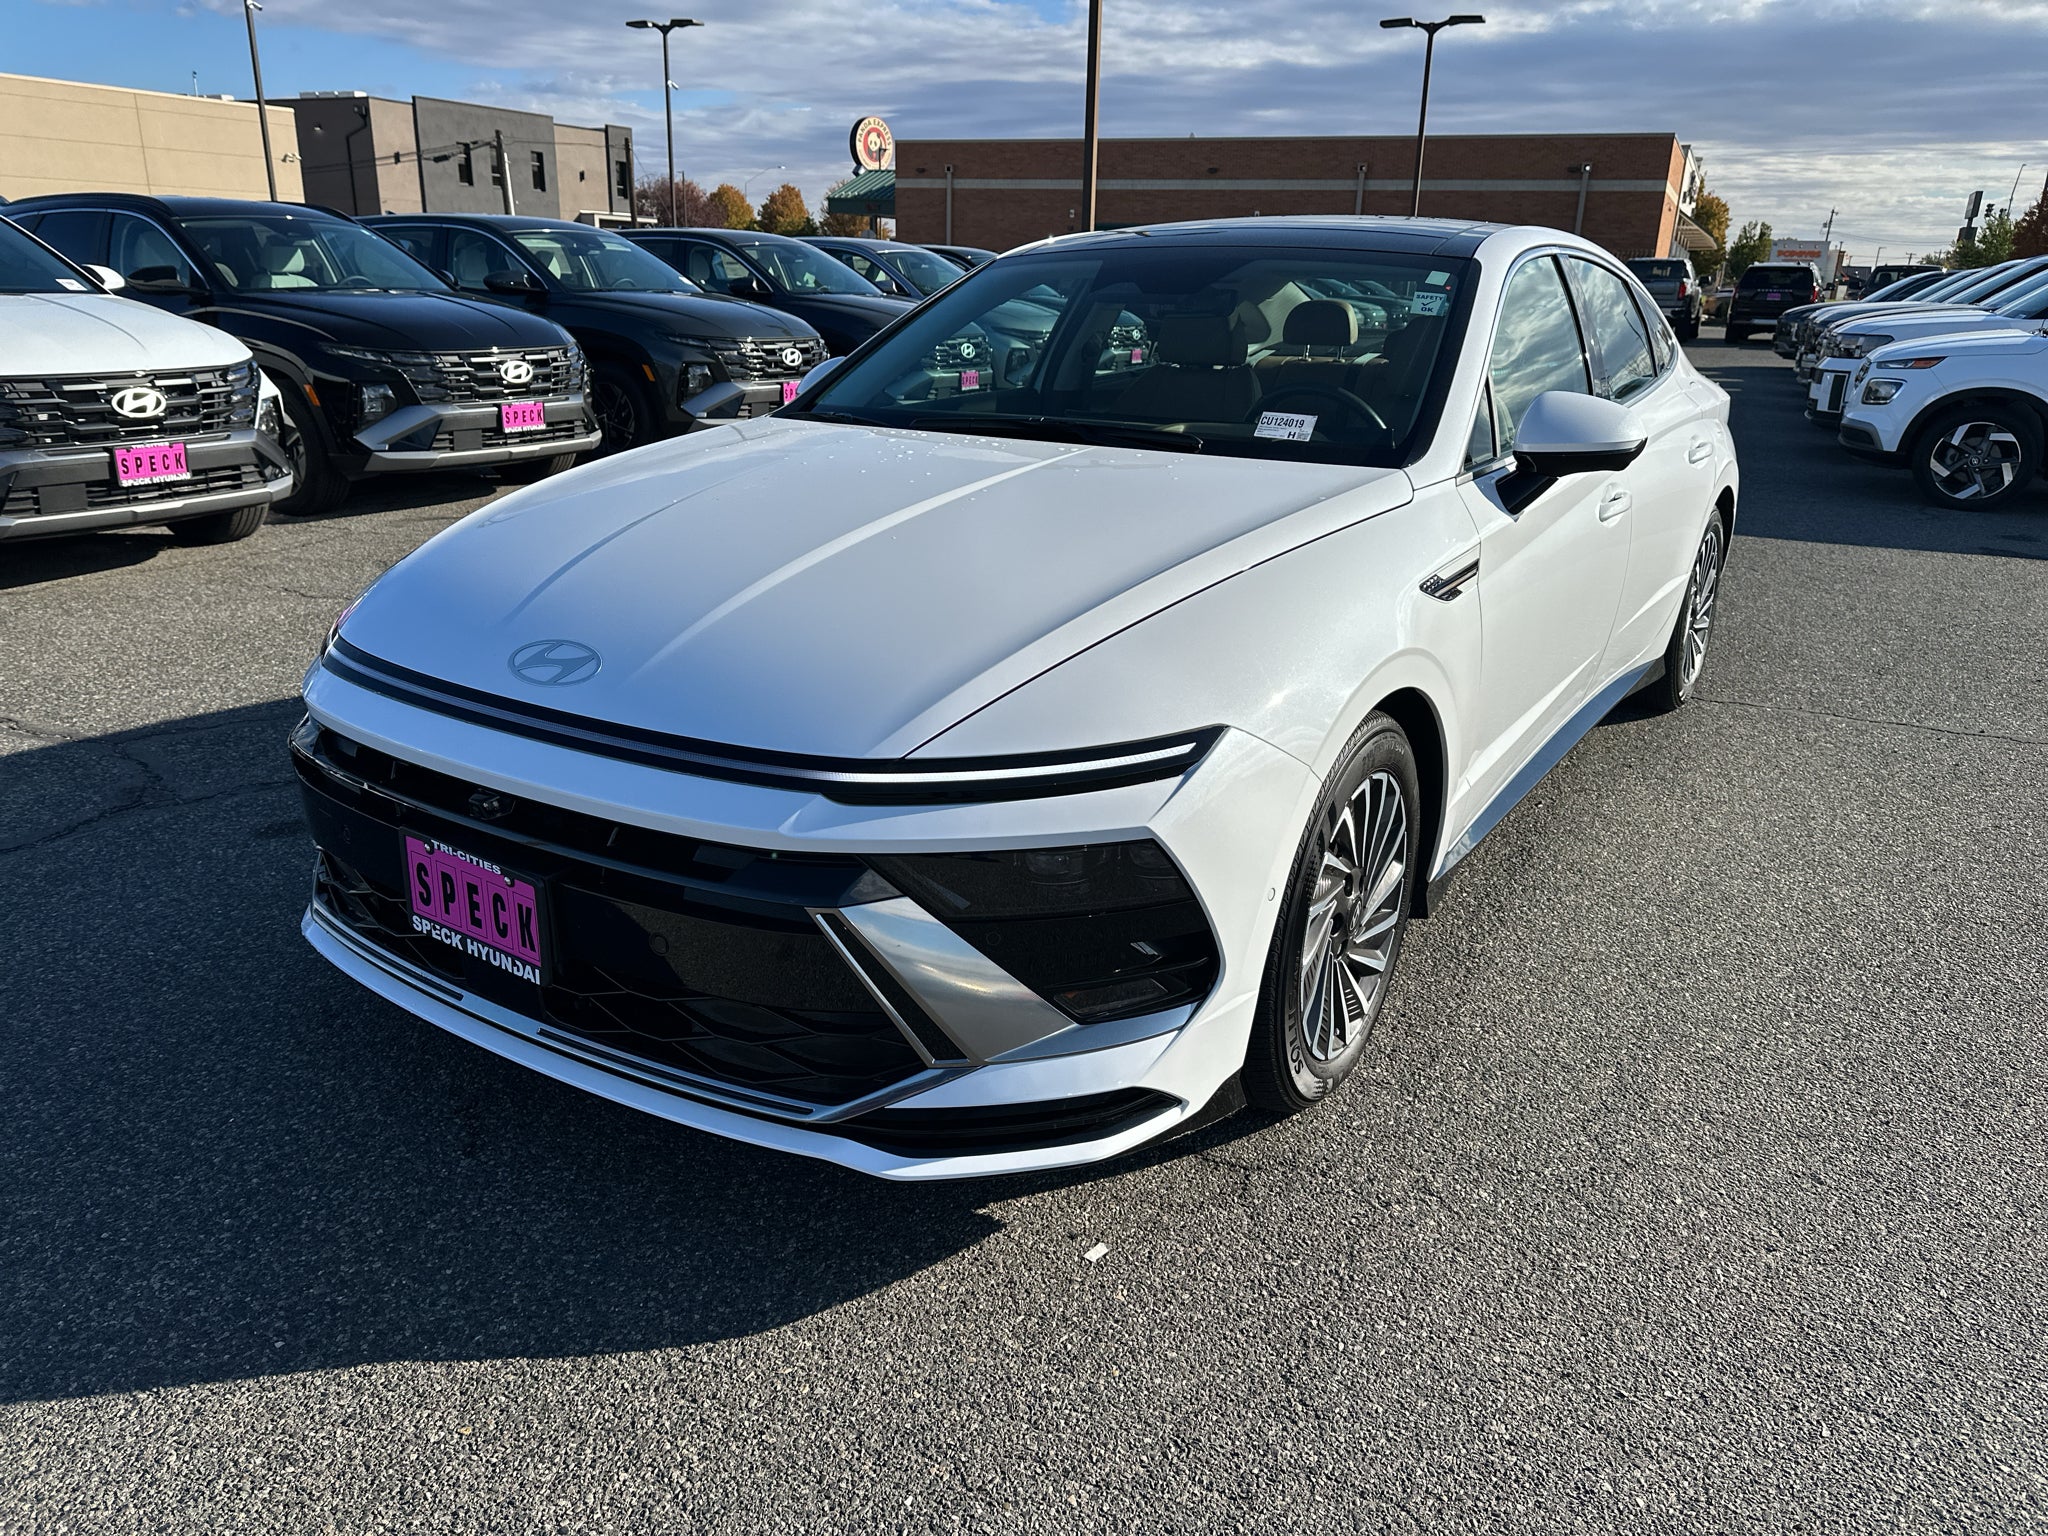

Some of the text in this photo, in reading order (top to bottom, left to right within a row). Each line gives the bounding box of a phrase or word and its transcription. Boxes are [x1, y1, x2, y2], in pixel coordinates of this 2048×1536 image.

[858, 119, 891, 145] PANDA EXPRESS
[505, 409, 542, 424] SPECK
[1260, 416, 1304, 428] CU124019
[121, 452, 184, 474] SPECK
[122, 472, 191, 487] SPECK HYUNDAI
[431, 839, 501, 875] TRI-CITIES
[416, 862, 536, 953] SPECK
[412, 915, 541, 985] SPECK HYUNDAI
